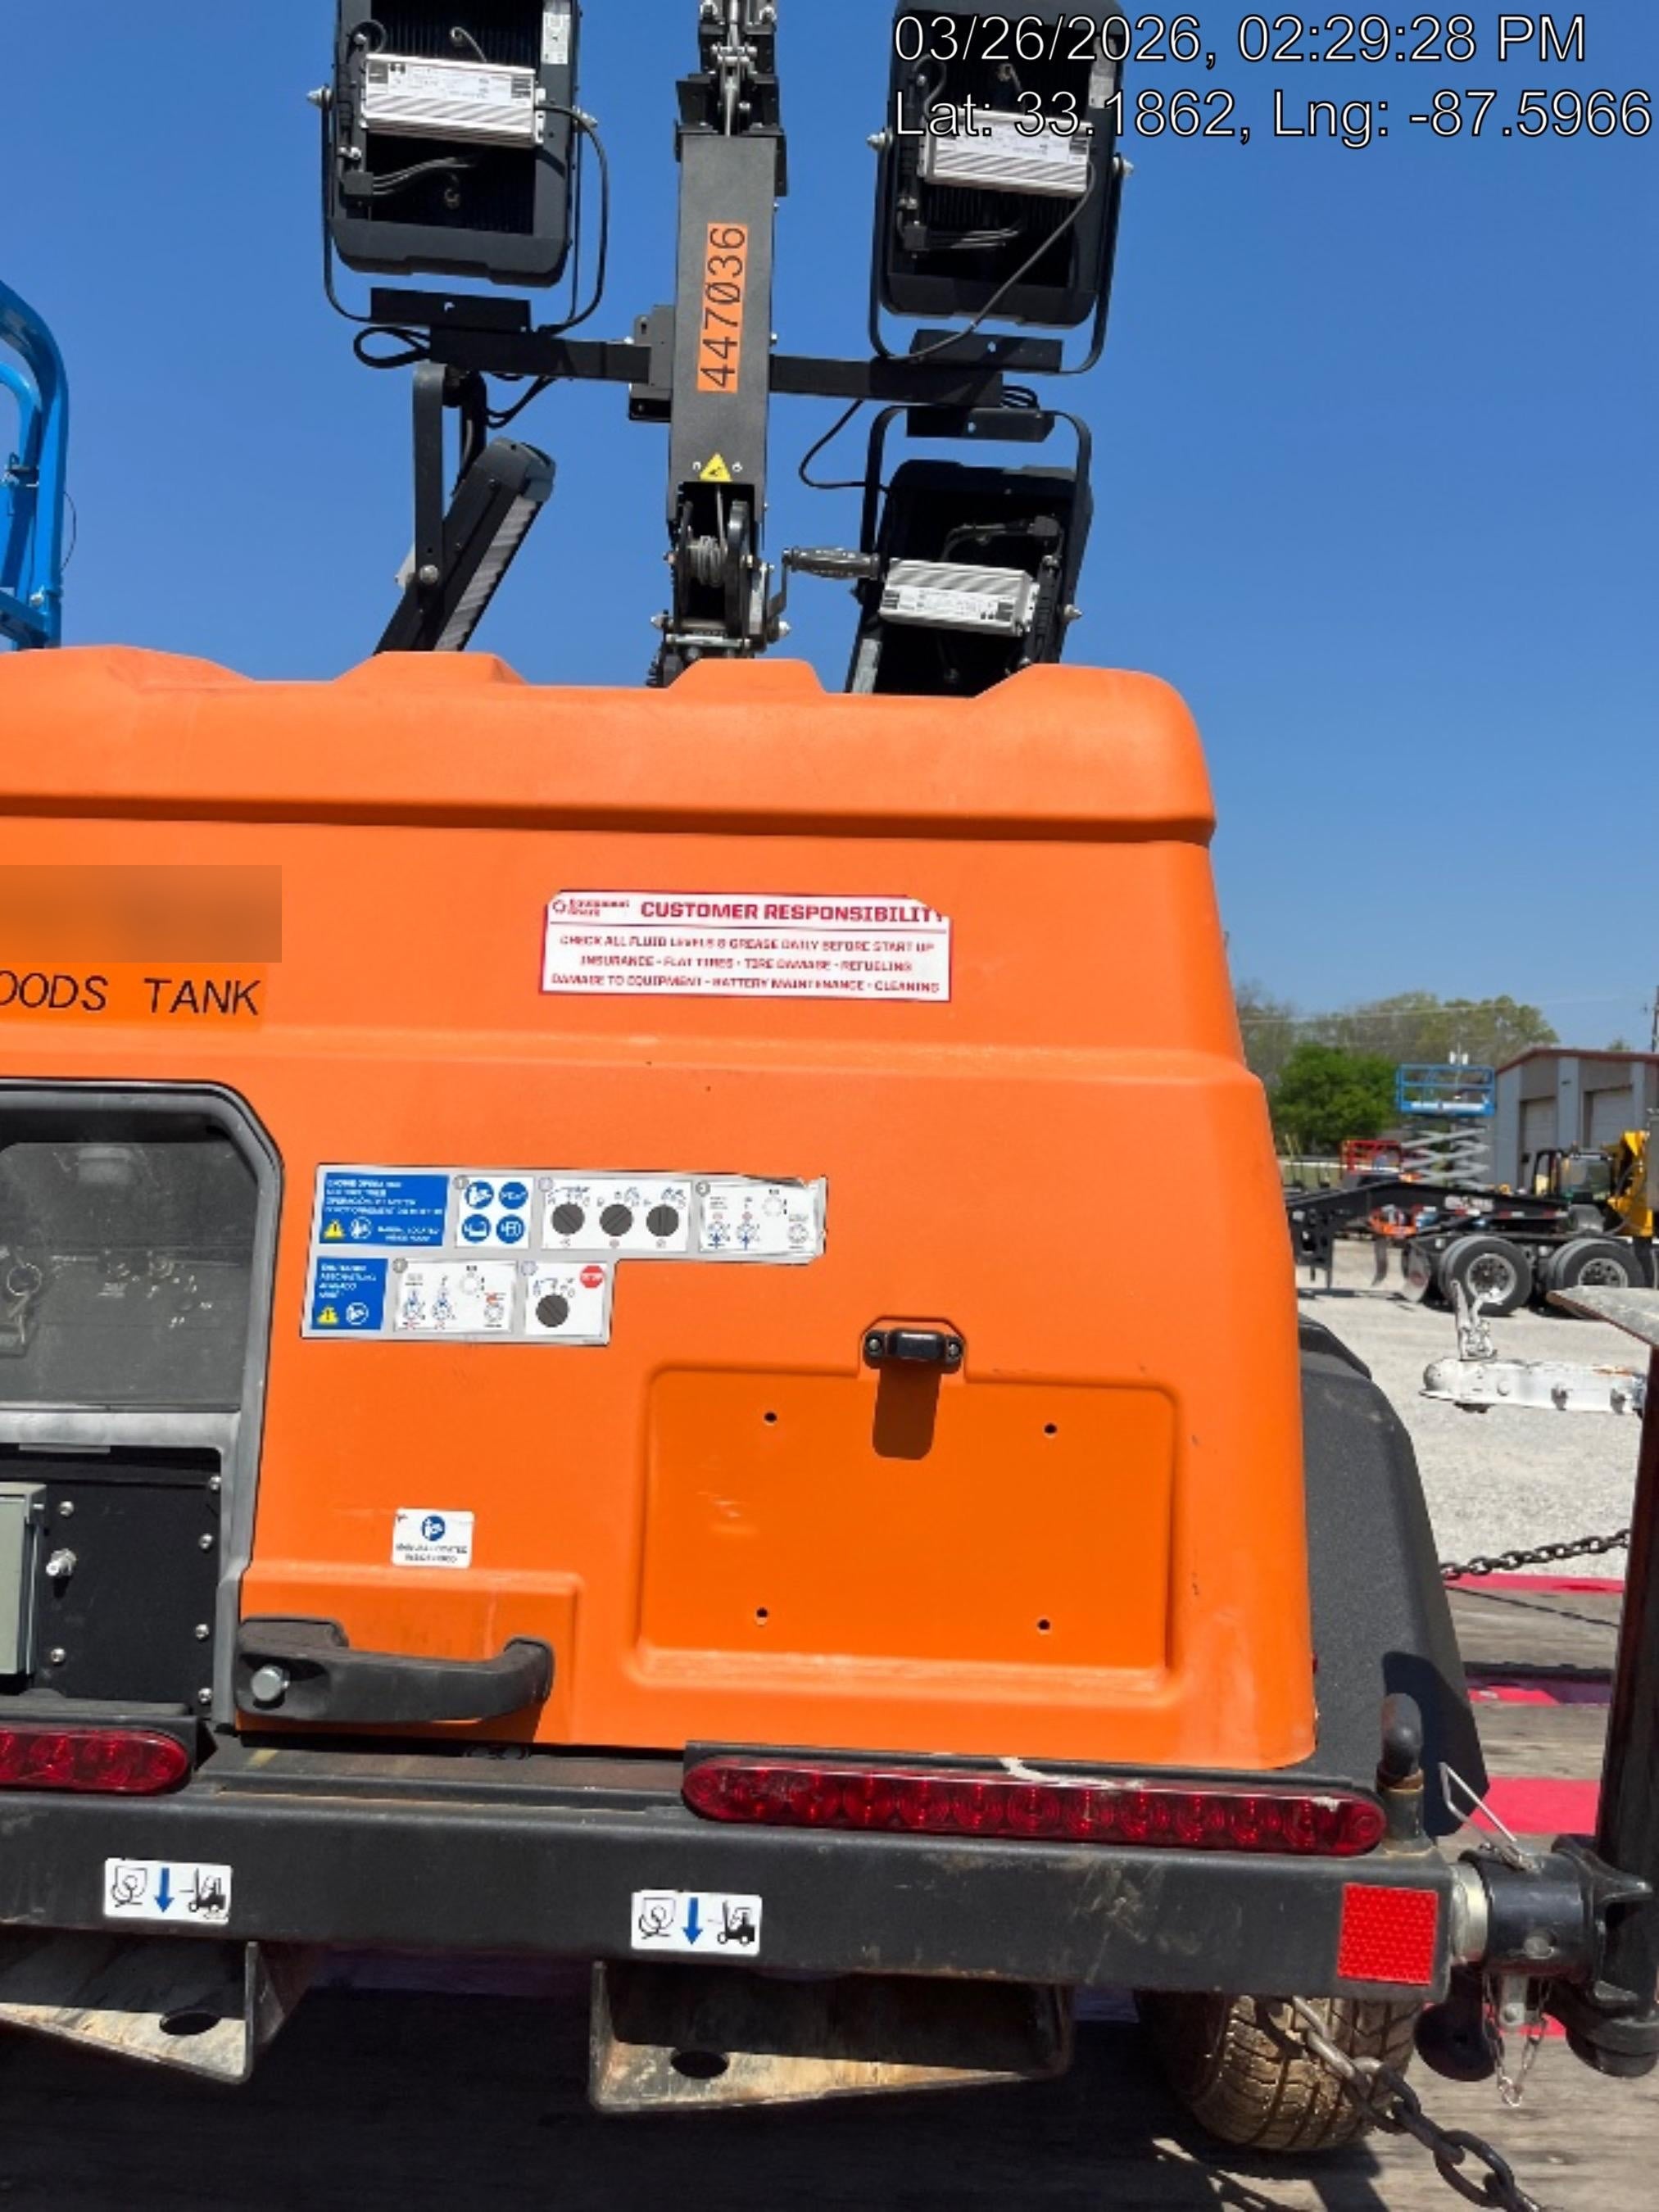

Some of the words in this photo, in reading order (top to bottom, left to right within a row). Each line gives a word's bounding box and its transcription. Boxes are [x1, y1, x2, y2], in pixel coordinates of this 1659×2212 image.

[640, 901, 758, 920] CUSTOMER
[628, 936, 667, 947] FLUID
[144, 977, 261, 1016] TANK
